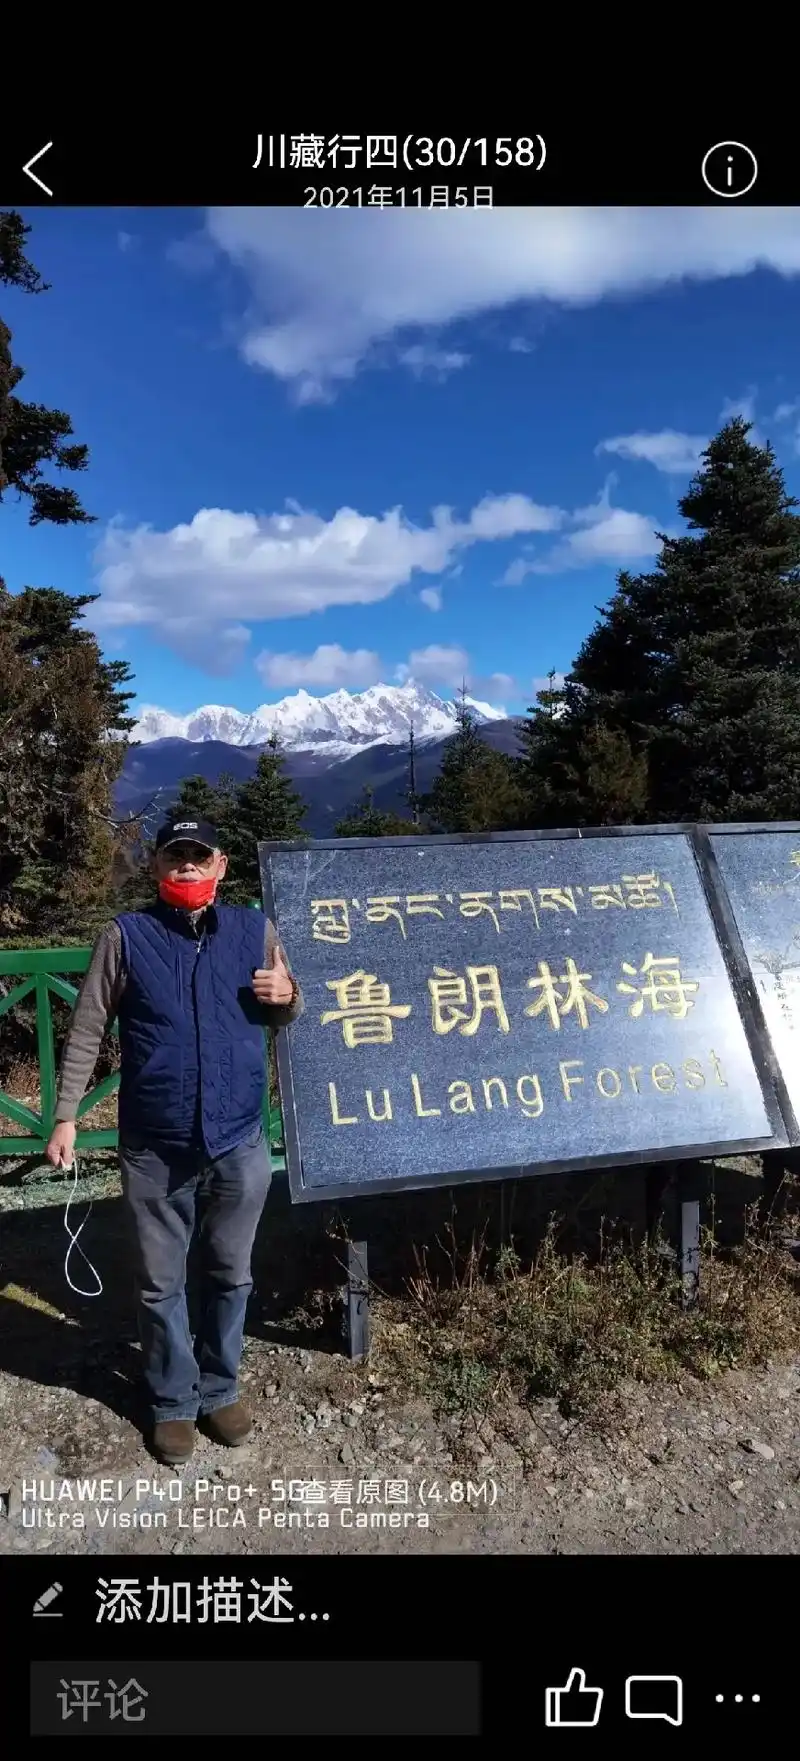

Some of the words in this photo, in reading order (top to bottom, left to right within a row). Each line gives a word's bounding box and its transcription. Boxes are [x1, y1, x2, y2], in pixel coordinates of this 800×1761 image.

[321, 951, 700, 1049] 鲁朗林海
[327, 1081, 393, 1126] Lu
[411, 1073, 545, 1119] Lang
[558, 1050, 729, 1103] Forest
